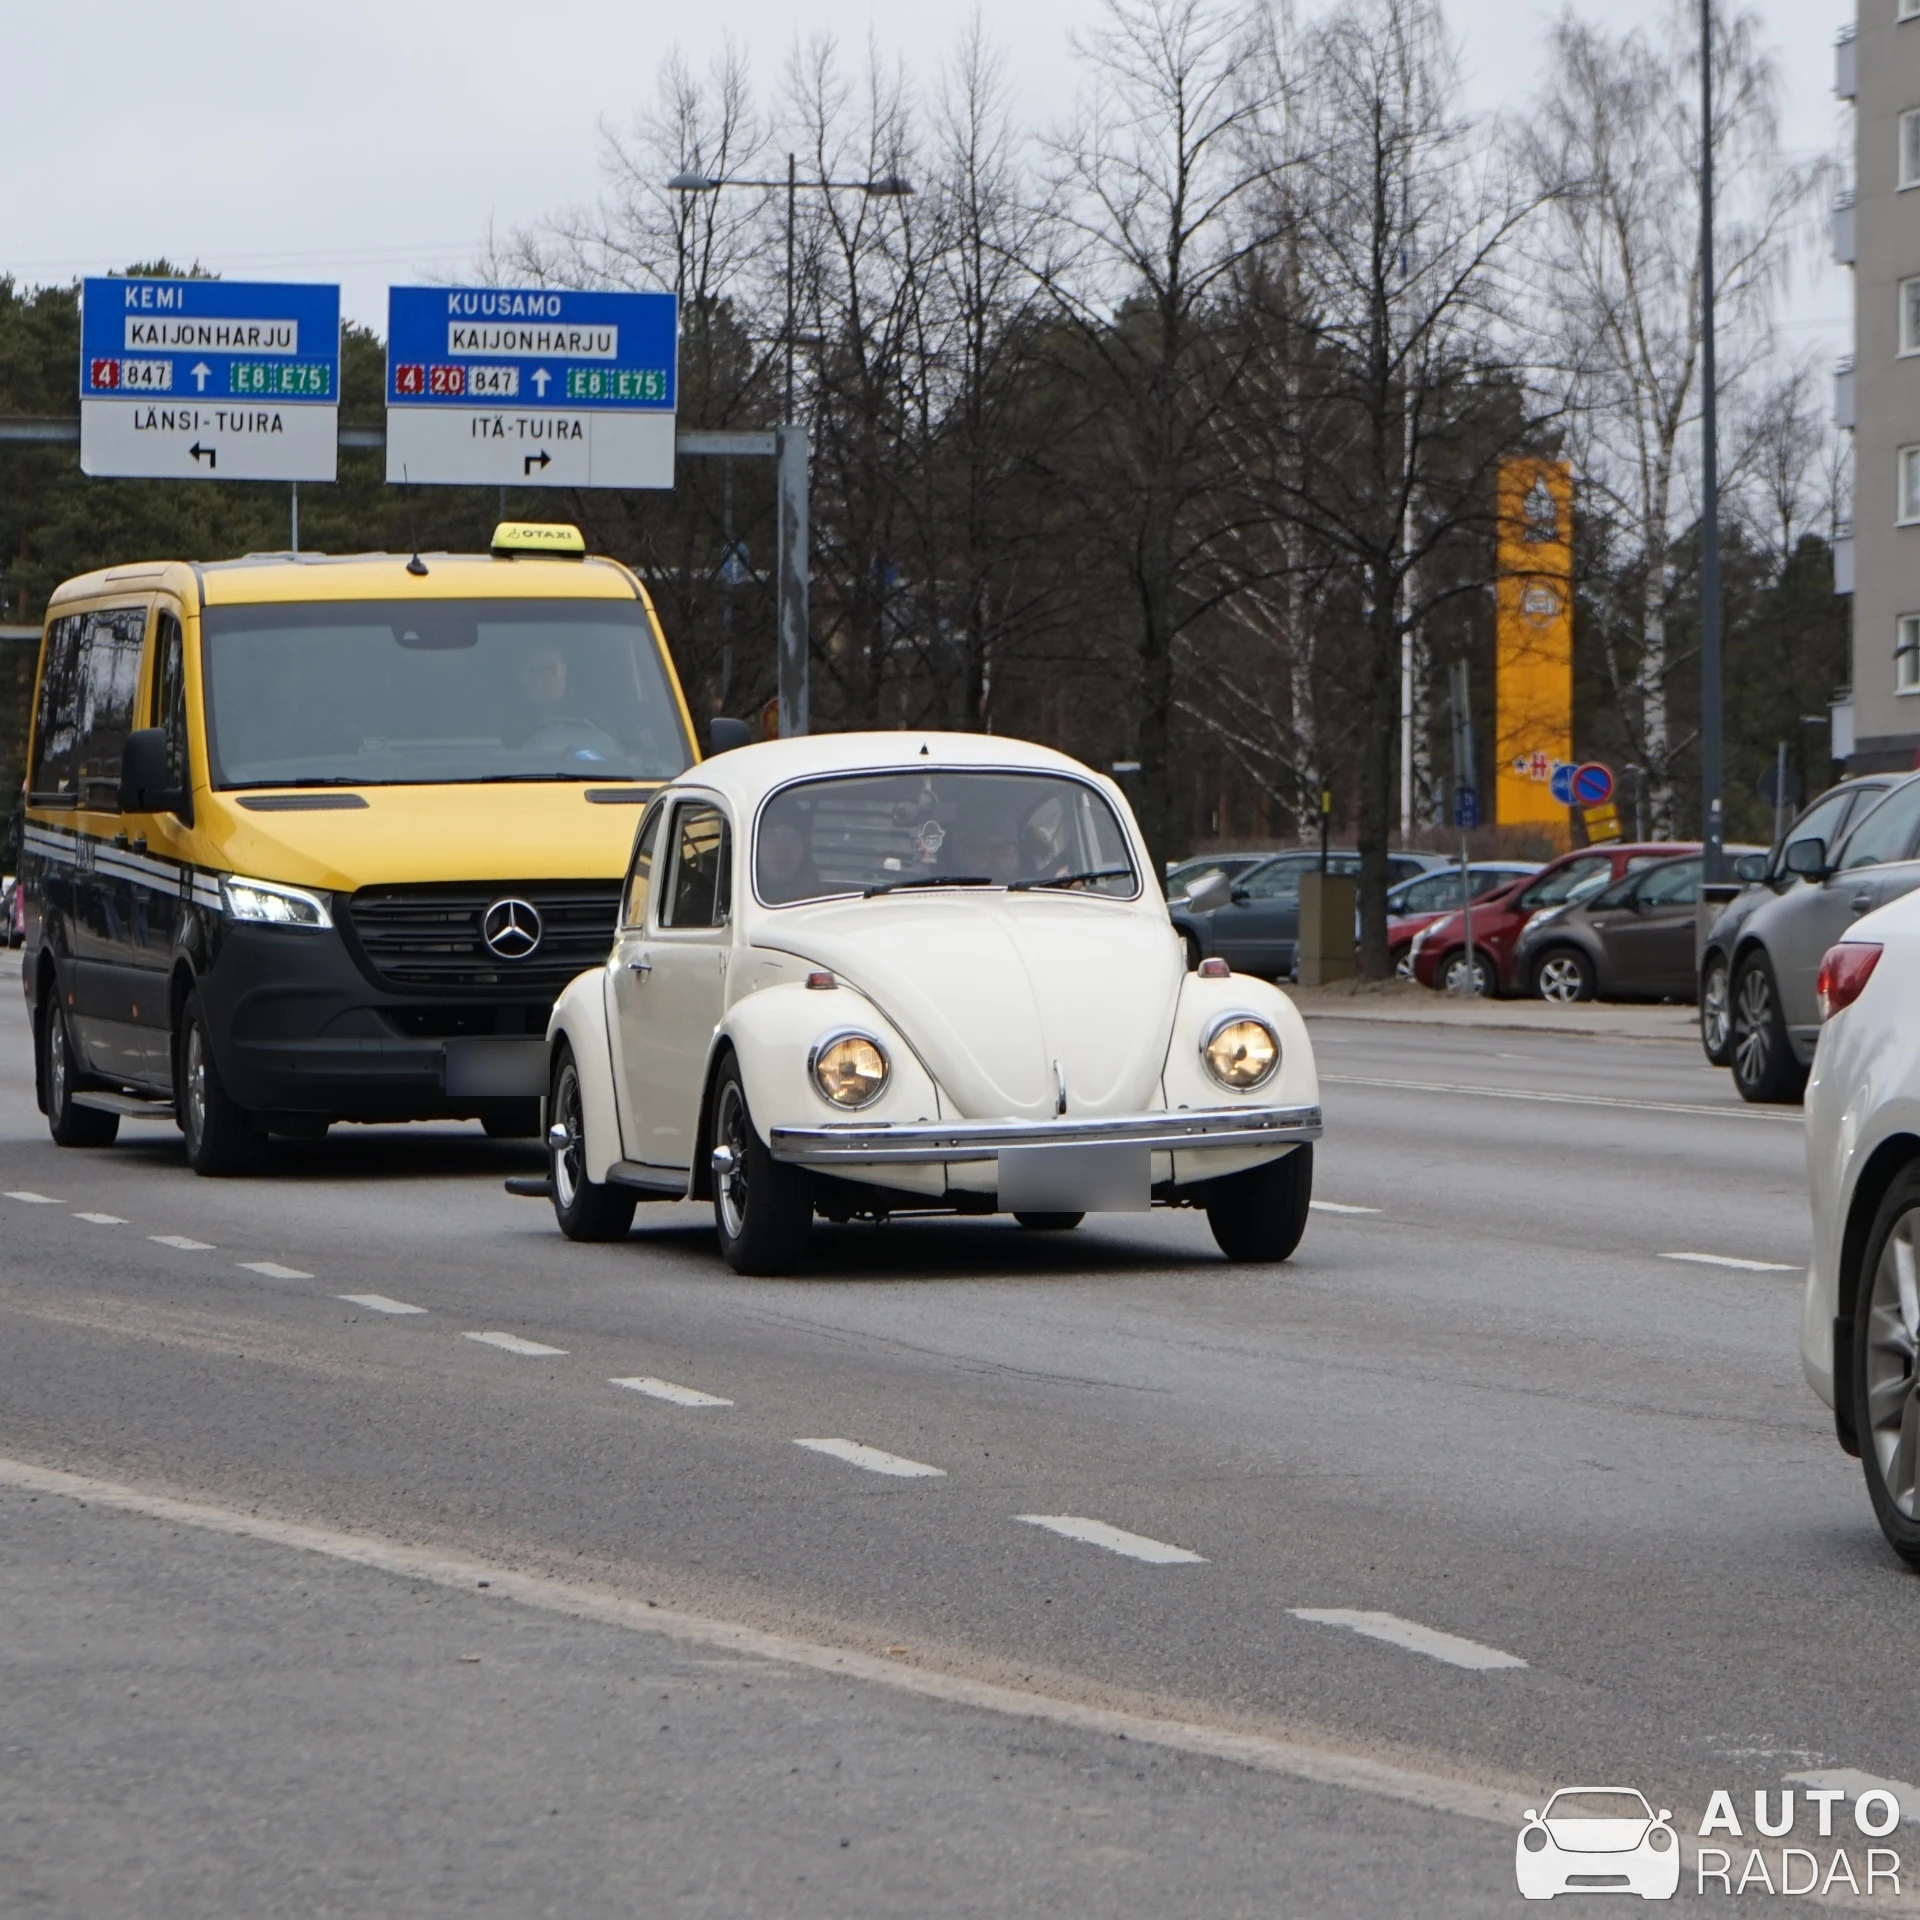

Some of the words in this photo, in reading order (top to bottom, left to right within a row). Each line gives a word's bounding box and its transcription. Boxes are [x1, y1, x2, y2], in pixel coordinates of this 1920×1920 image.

[125, 286, 183, 309] KEMI
[448, 293, 561, 317] KUUSAMO
[131, 323, 291, 347] KAIJONHARJU
[453, 329, 611, 352] KAIJONHARJU
[98, 364, 112, 385] 4
[127, 366, 165, 385] 847
[238, 369, 264, 389] E8
[281, 370, 321, 390] E75
[403, 371, 417, 389] 4
[434, 370, 461, 390] 20
[474, 372, 512, 392] 847
[574, 374, 600, 394] E8
[619, 375, 658, 395] E75
[134, 406, 283, 433] LÄNSI-TUIRA
[472, 415, 583, 440] ITÄ-TUIRA
[522, 529, 572, 539] OTAXI
